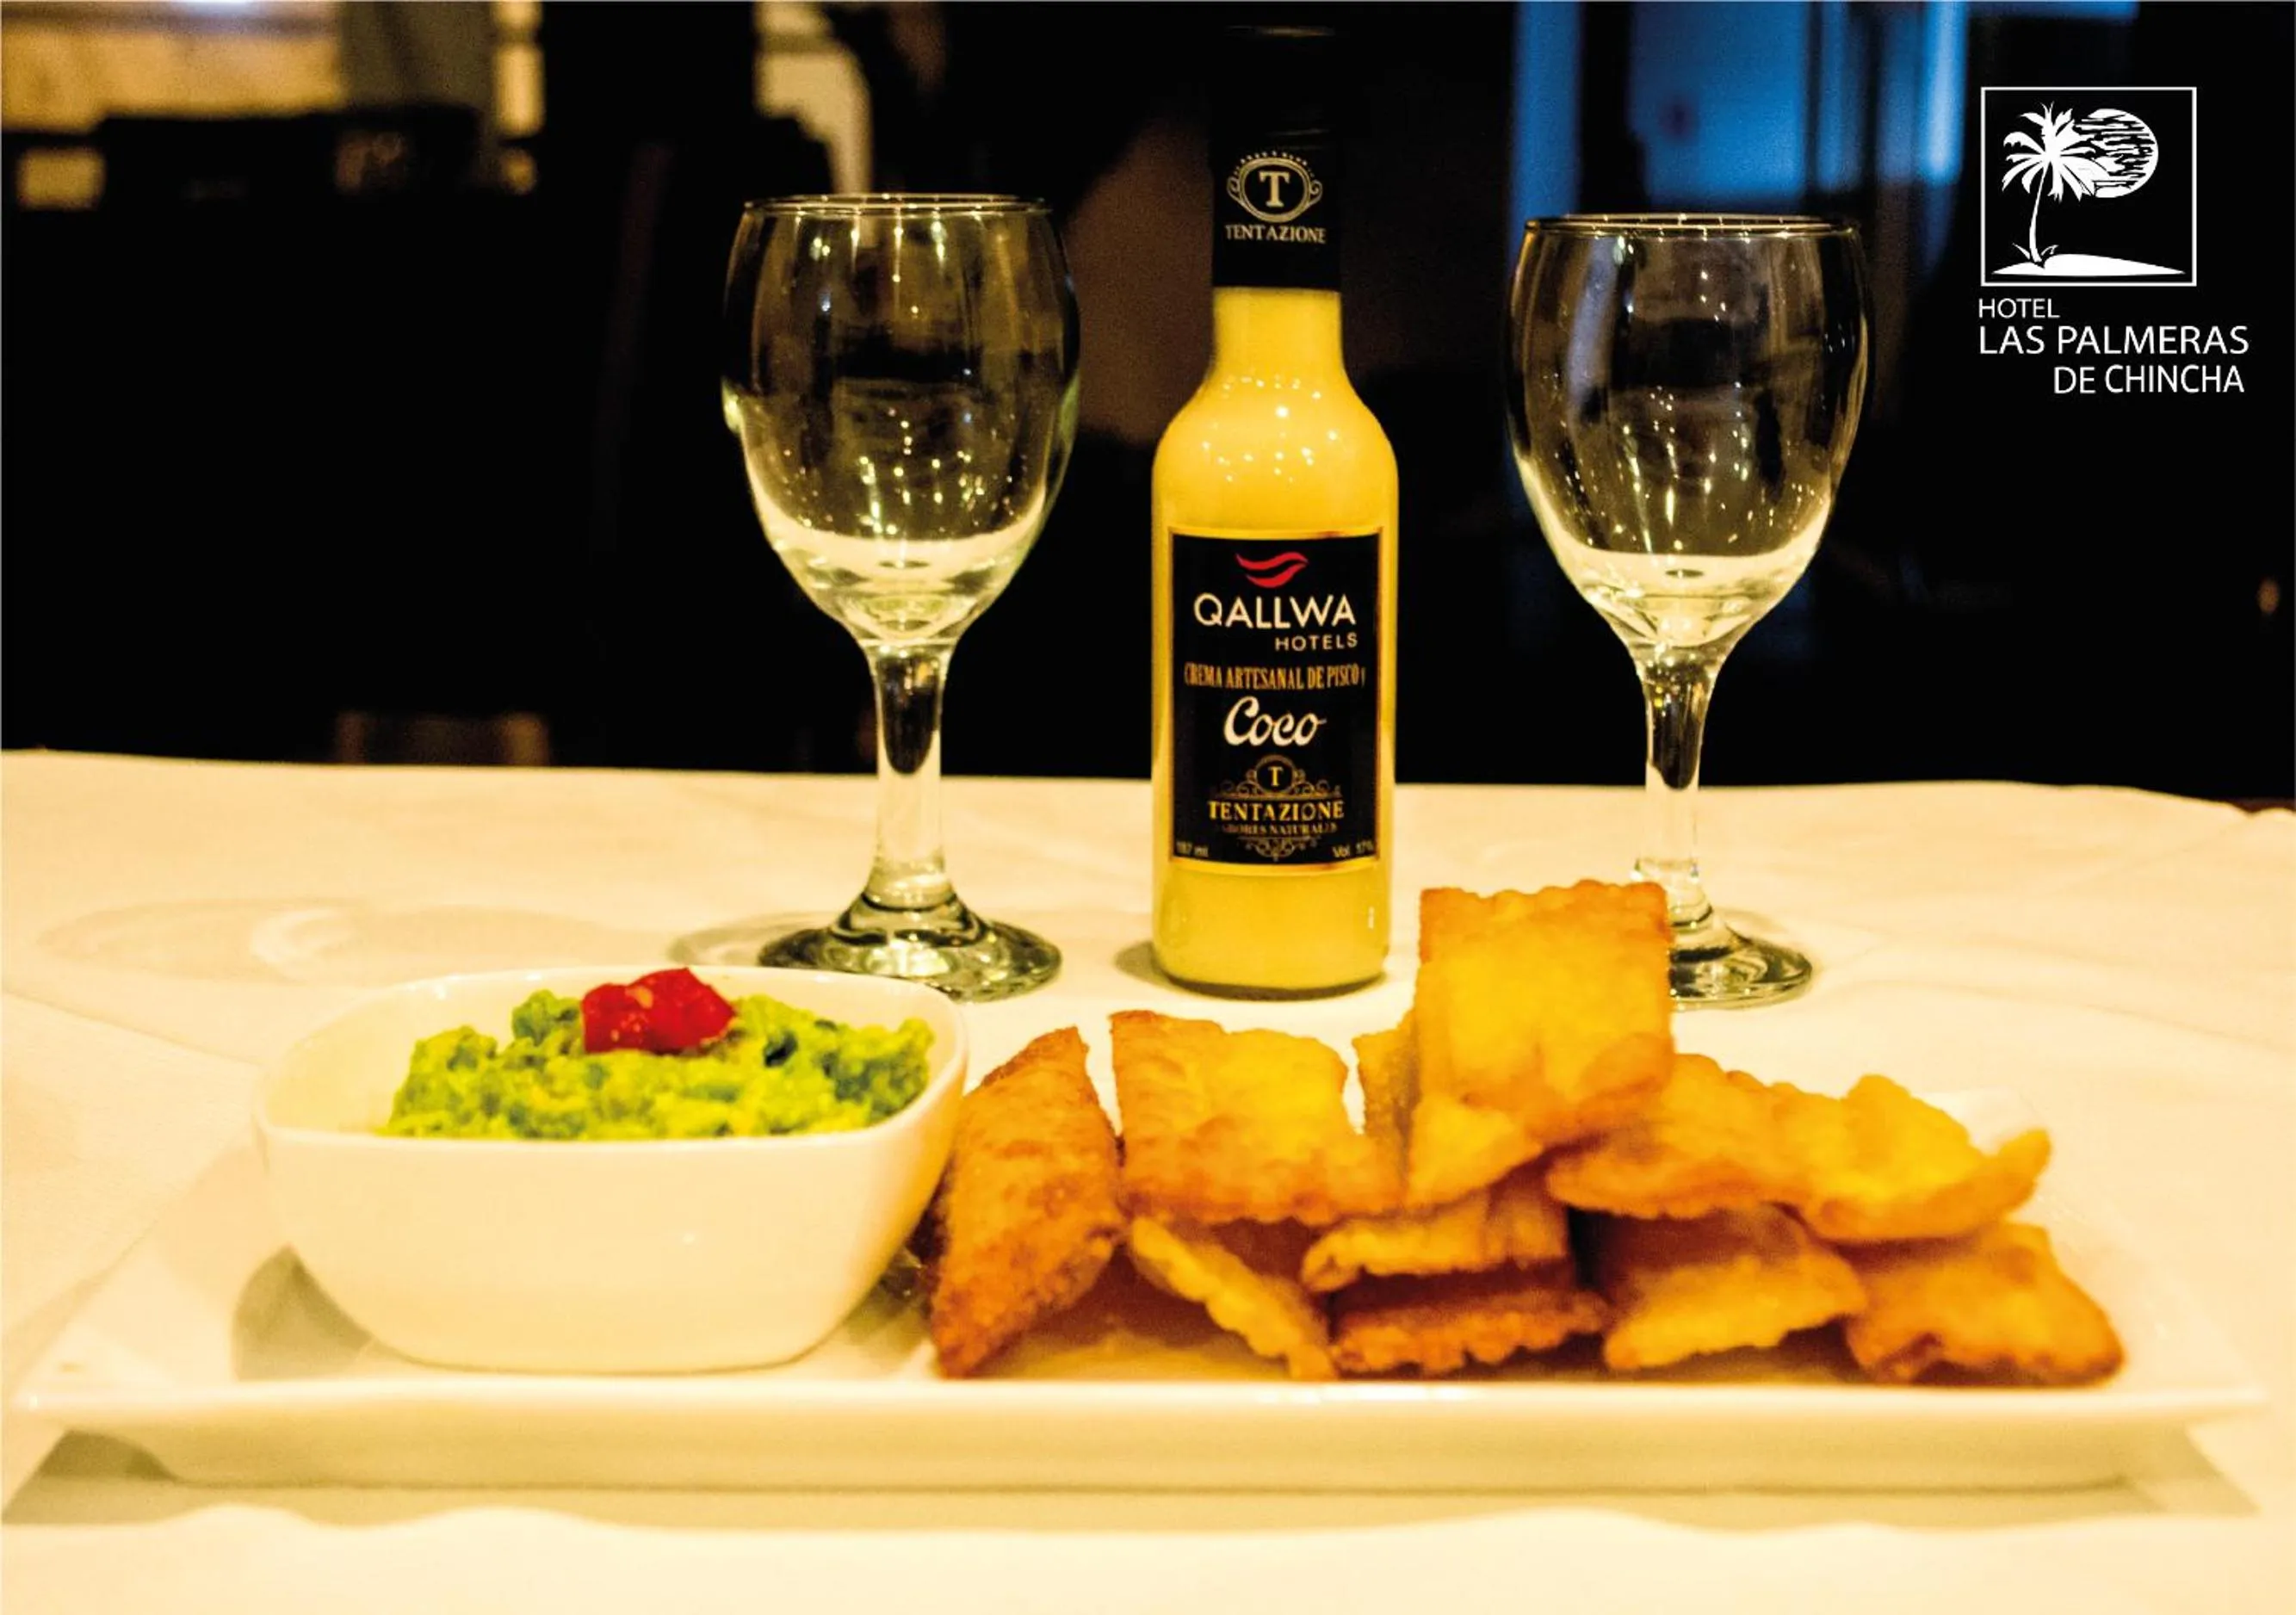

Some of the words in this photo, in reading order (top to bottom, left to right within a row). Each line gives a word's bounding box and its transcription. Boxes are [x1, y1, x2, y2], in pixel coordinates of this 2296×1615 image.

[1225, 224, 1327, 244] TENTAZIONE
[1193, 592, 1357, 629] QALLWA
[1275, 632, 1358, 652] HOTELS
[1184, 661, 1222, 688] CREMA
[1225, 665, 1305, 690] ARTESANAL
[1307, 665, 1325, 690] DE
[1327, 663, 1359, 689] PISCO
[1223, 696, 1327, 747] Coco
[1207, 801, 1345, 821] TENTAZIONE
